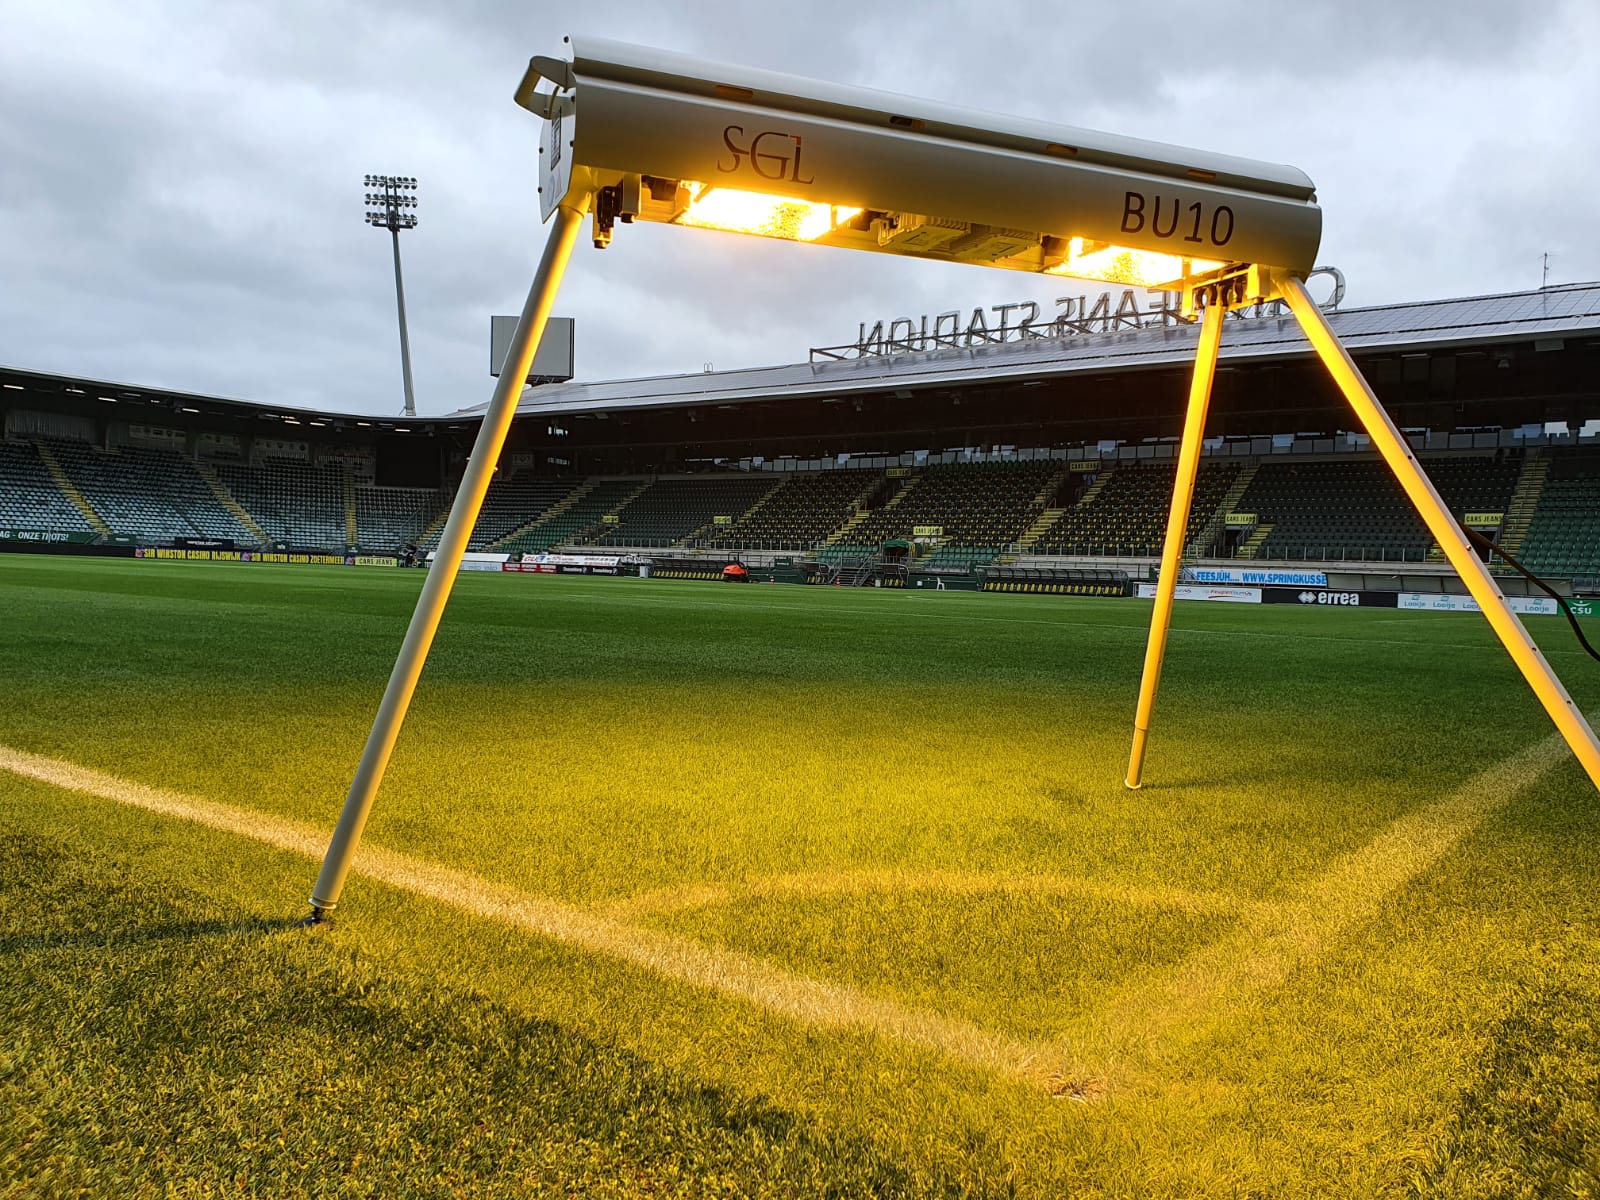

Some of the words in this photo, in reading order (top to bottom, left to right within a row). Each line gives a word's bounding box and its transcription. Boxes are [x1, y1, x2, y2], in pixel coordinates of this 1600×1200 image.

[717, 125, 815, 185] SGL
[1120, 191, 1234, 246] BU10
[18, 531, 40, 540] ONZE
[144, 548, 155, 558] SIR
[157, 549, 185, 559] WINSTON
[187, 550, 210, 560] CASINO
[212, 551, 241, 561] RIJSWIJK
[251, 552, 261, 562] SIR
[263, 553, 288, 563] WINSTON
[289, 554, 309, 563] CASINO
[1242, 572, 1327, 584] WWW.SPRINGKUSSE
[1318, 592, 1359, 606] errea
[1404, 600, 1426, 608] Looije
[1433, 601, 1456, 609] Looije
[1524, 604, 1550, 612] Looije
[1570, 606, 1592, 615] CSU
